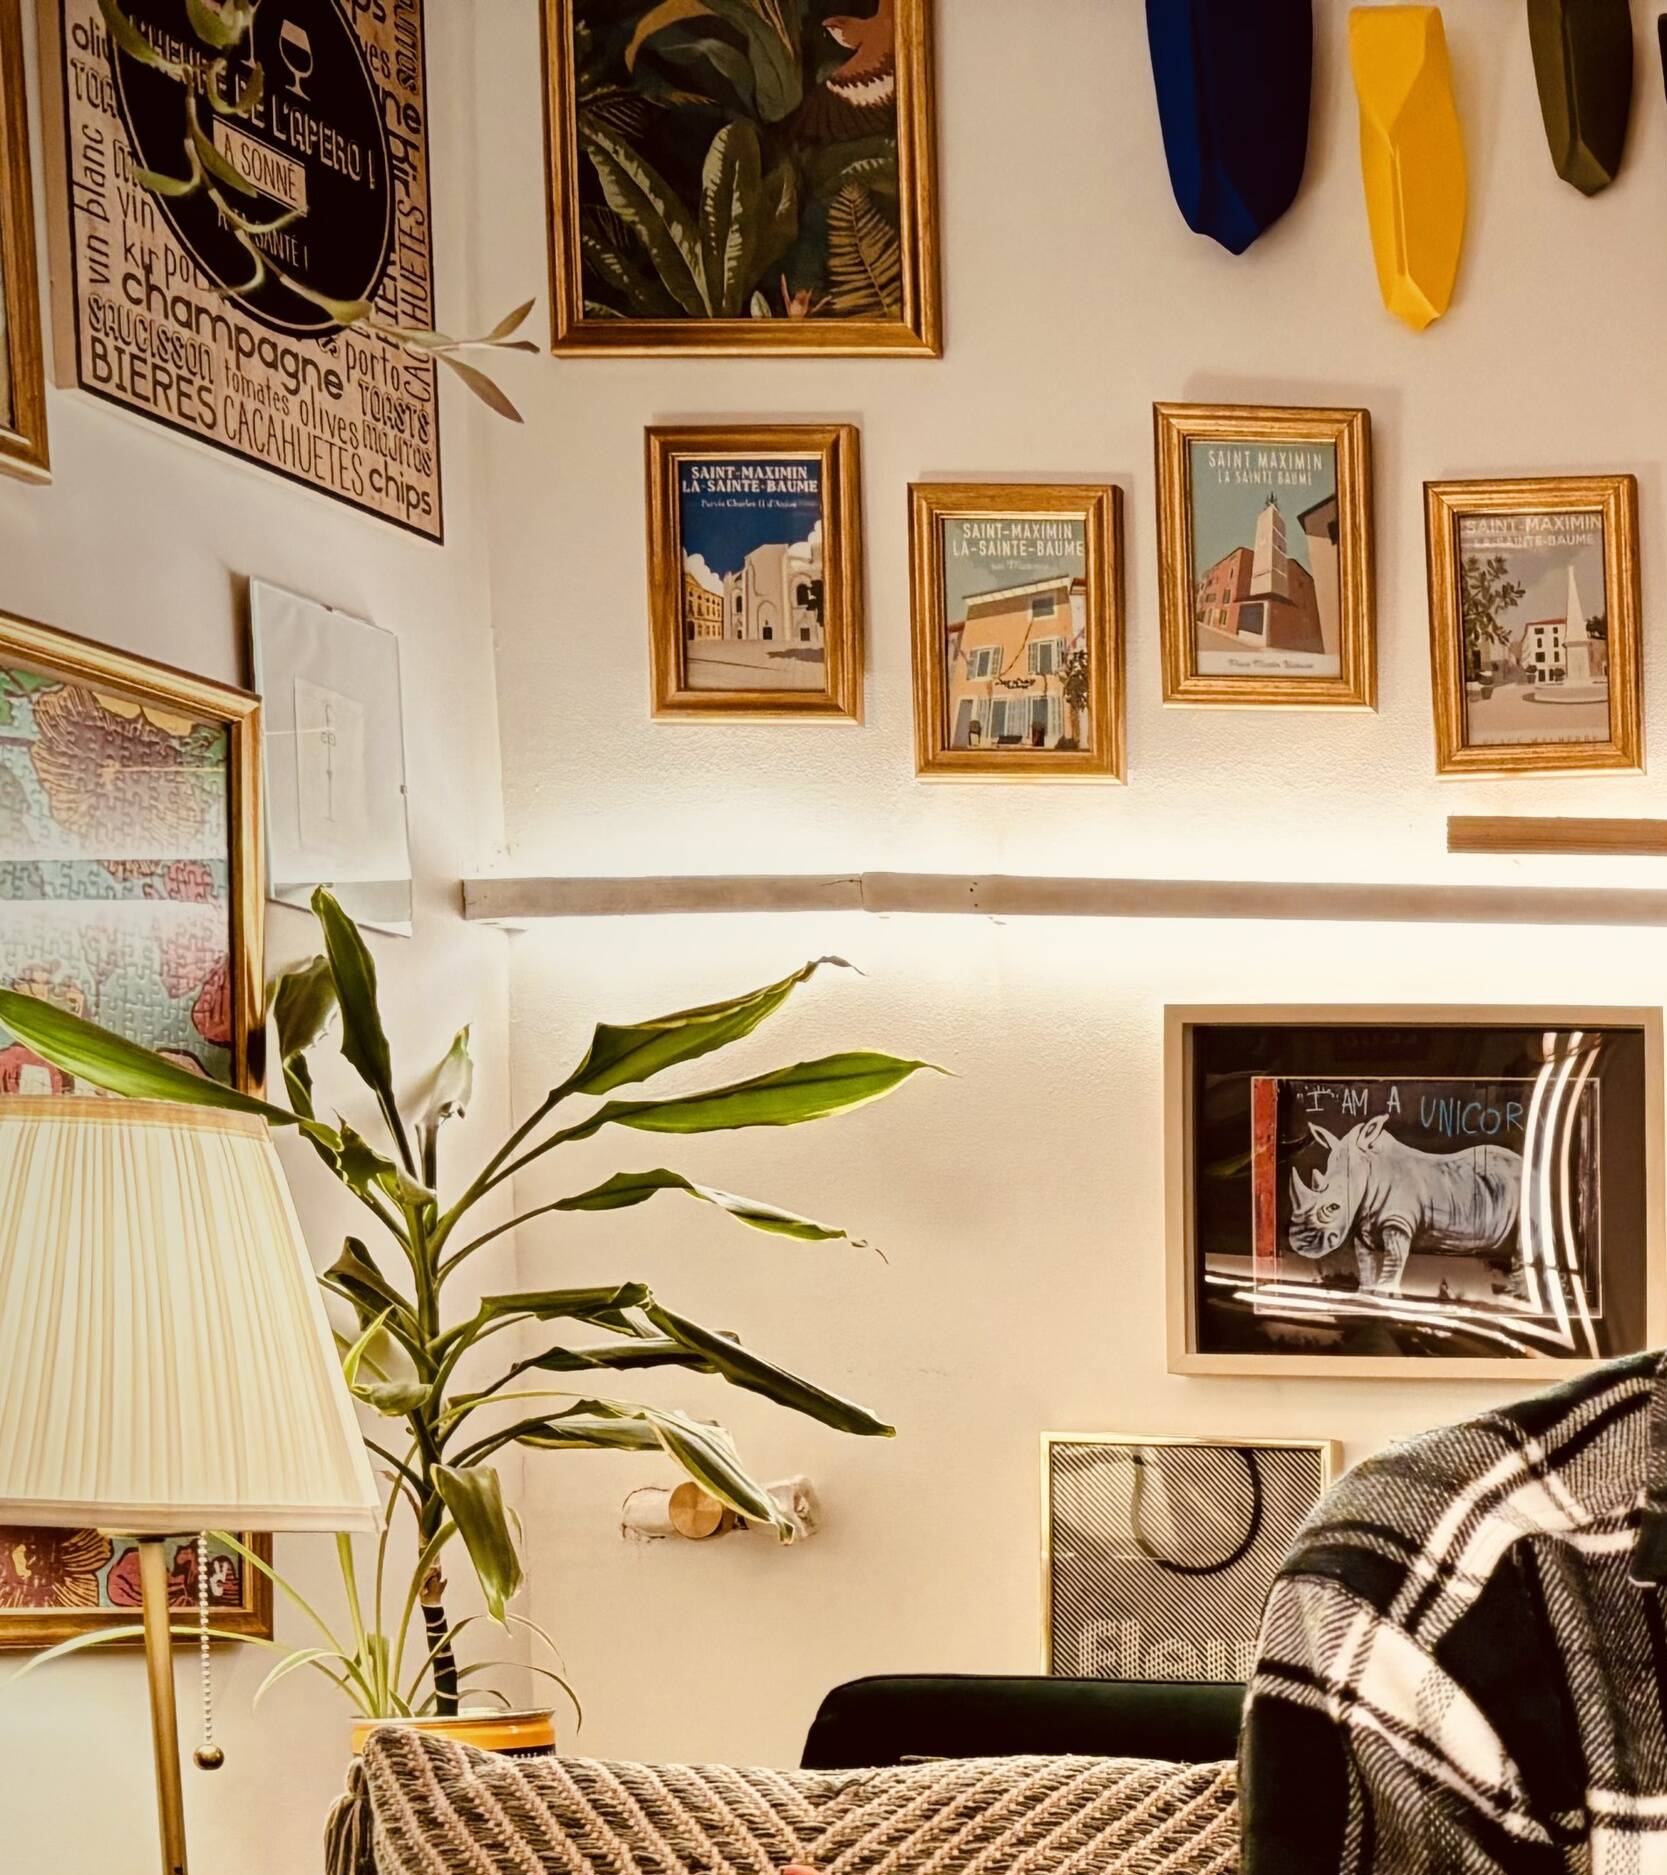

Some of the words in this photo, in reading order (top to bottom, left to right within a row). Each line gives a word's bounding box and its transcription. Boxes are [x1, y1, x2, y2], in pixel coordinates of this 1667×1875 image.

[271, 94, 362, 182] L'APERO
[73, 124, 111, 224] blanc
[240, 142, 297, 202] SONNÉ
[116, 186, 155, 233] vin
[85, 234, 111, 285] vin
[122, 219, 160, 276] kir
[121, 261, 344, 400] champagne
[397, 198, 432, 403] CACHUETES
[90, 334, 217, 430] BIERES
[346, 339, 399, 392] porto
[224, 357, 290, 416] tomates
[300, 385, 360, 450] olives
[357, 378, 431, 445] TOASTS
[223, 394, 364, 497] CACAHUETES
[691, 465, 808, 480] SAINT-MAXIMIN
[1208, 450, 1250, 469] SAINT
[1258, 451, 1323, 471] MAXIMIN
[368, 459, 432, 520] chips
[952, 540, 1085, 557] LA-SAINTE-BAUME
[962, 523, 1073, 539] SAINT-MAXIMIN
[1341, 1087, 1369, 1117] AM
[1386, 1085, 1401, 1115] A
[1420, 1093, 1549, 1138] UNICOR
